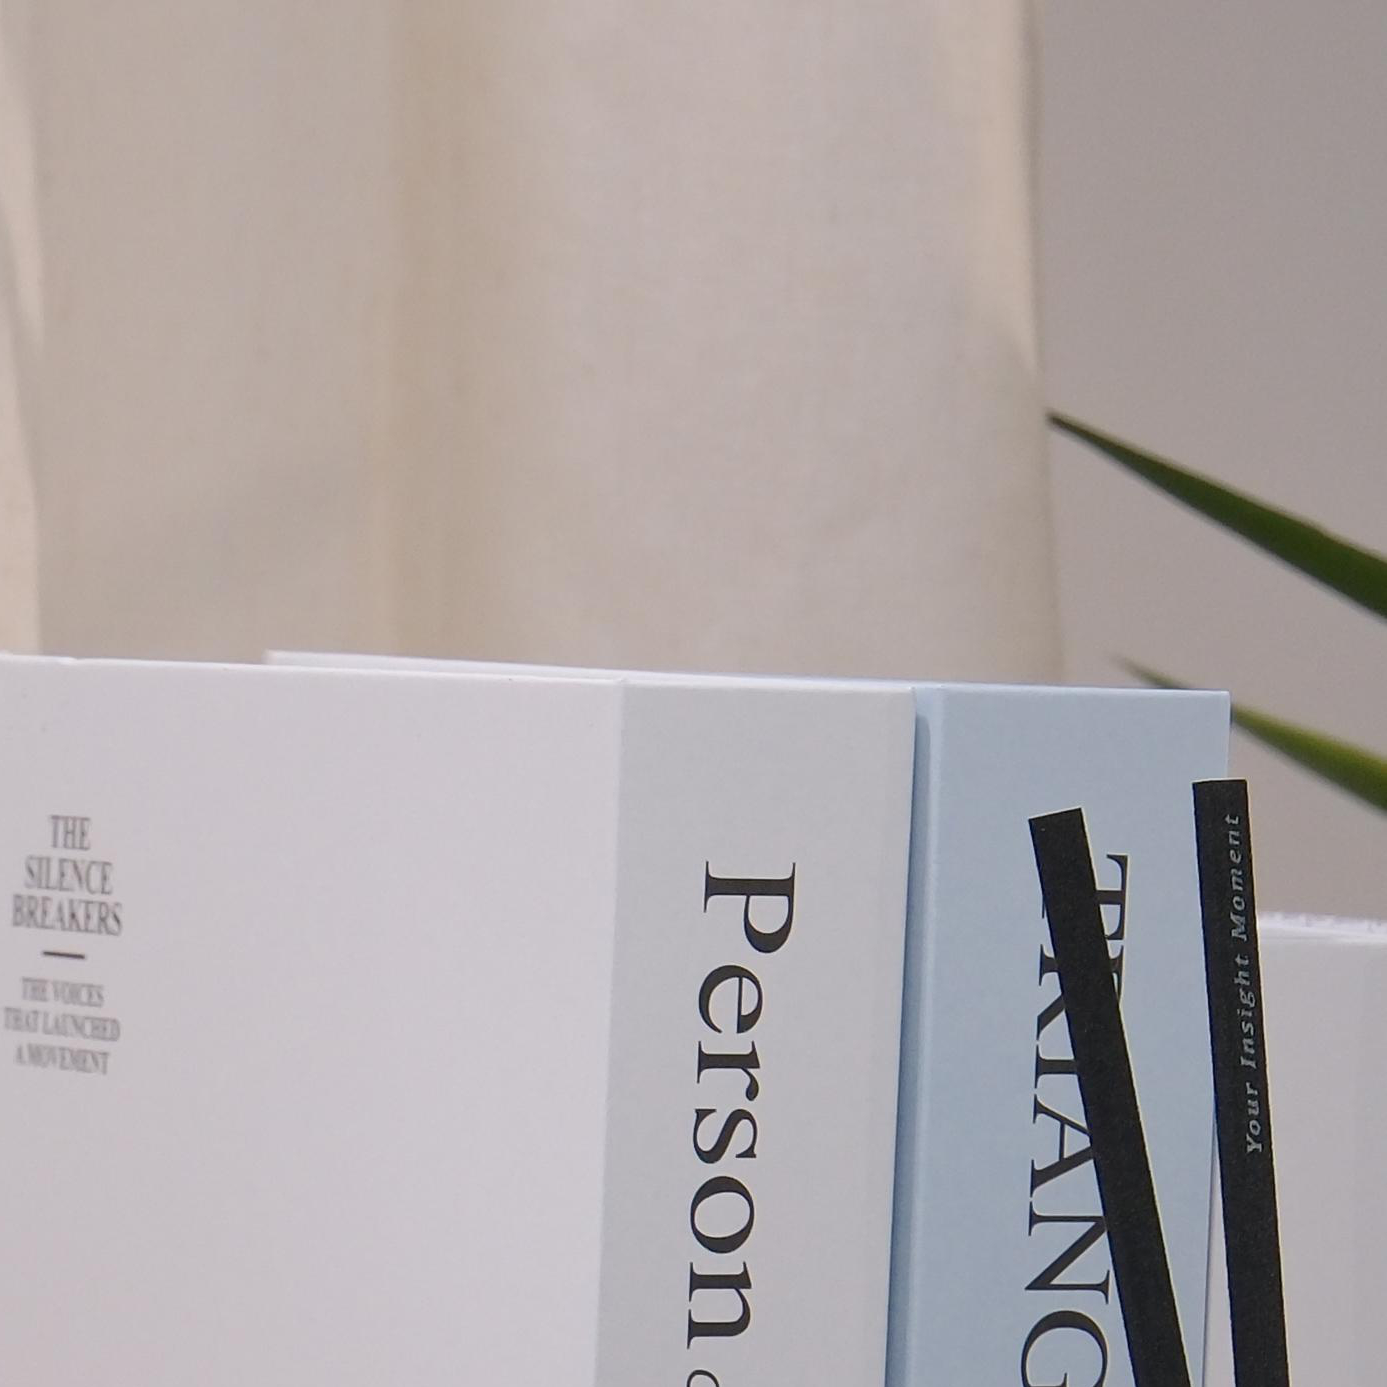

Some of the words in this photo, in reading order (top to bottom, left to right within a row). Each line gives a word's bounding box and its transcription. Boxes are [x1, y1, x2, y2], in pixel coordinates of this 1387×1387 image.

[50, 814, 92, 851] THE
[24, 855, 113, 896] SILENCE
[1224, 813, 1249, 942] Moment
[11, 893, 123, 937] BREAKERS
[21, 976, 48, 1002] THE
[52, 979, 105, 1008] VOICES
[1233, 953, 1258, 1069] Insight
[3, 1006, 39, 1033] THAT
[43, 1012, 121, 1042] LAUNCHED
[15, 1043, 25, 1066] A
[27, 1044, 110, 1076] MOVEMENT
[686, 861, 796, 1350] Person
[1246, 1082, 1263, 1154] Your
